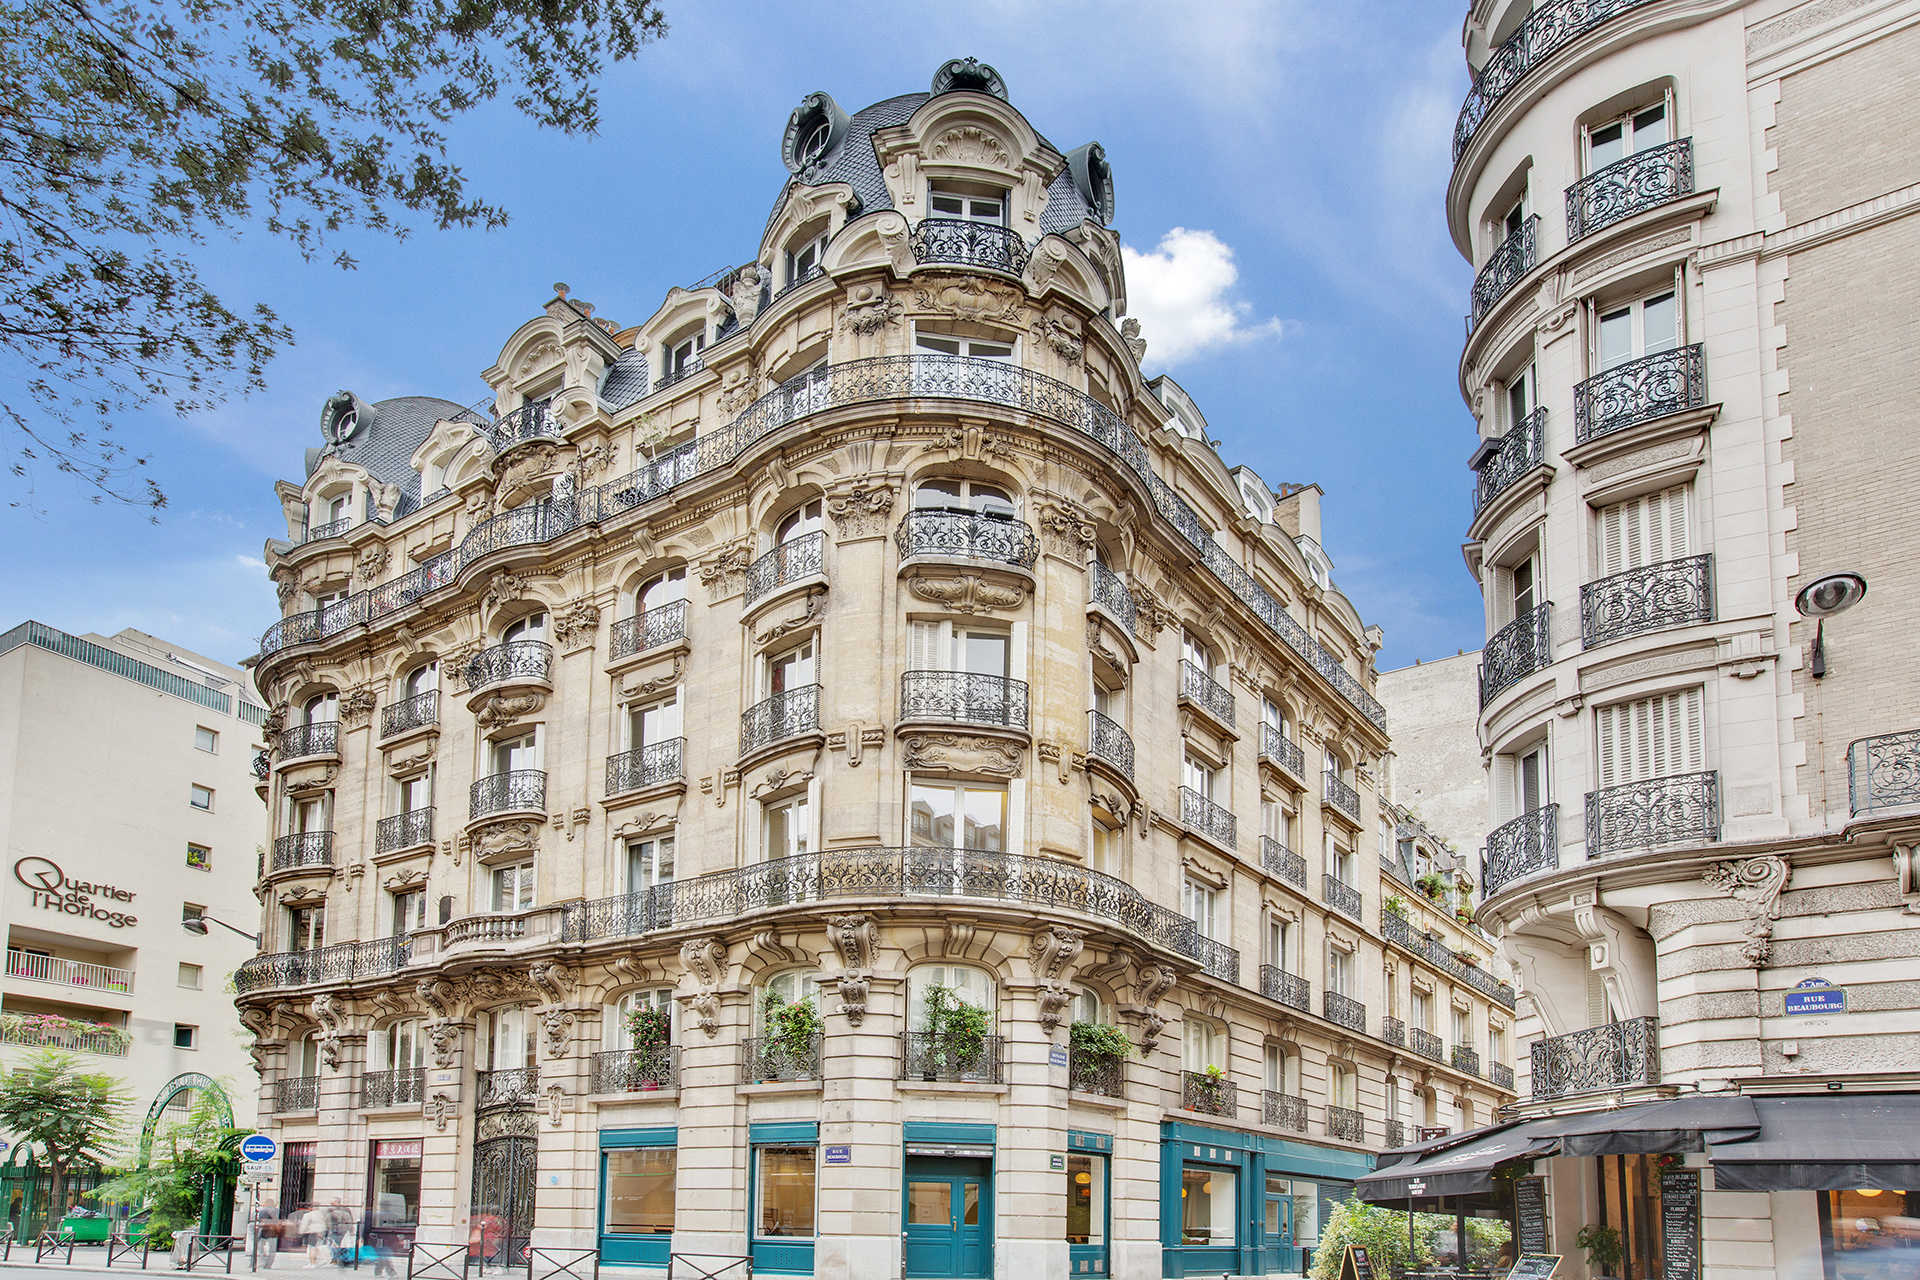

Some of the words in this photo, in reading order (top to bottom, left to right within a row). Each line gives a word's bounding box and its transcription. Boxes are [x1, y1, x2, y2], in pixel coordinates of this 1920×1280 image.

[14, 856, 137, 903] Quartier
[32, 891, 138, 928] l'Horloge
[65, 890, 90, 905] de
[1787, 1003, 1843, 1012] BEAUBOURG
